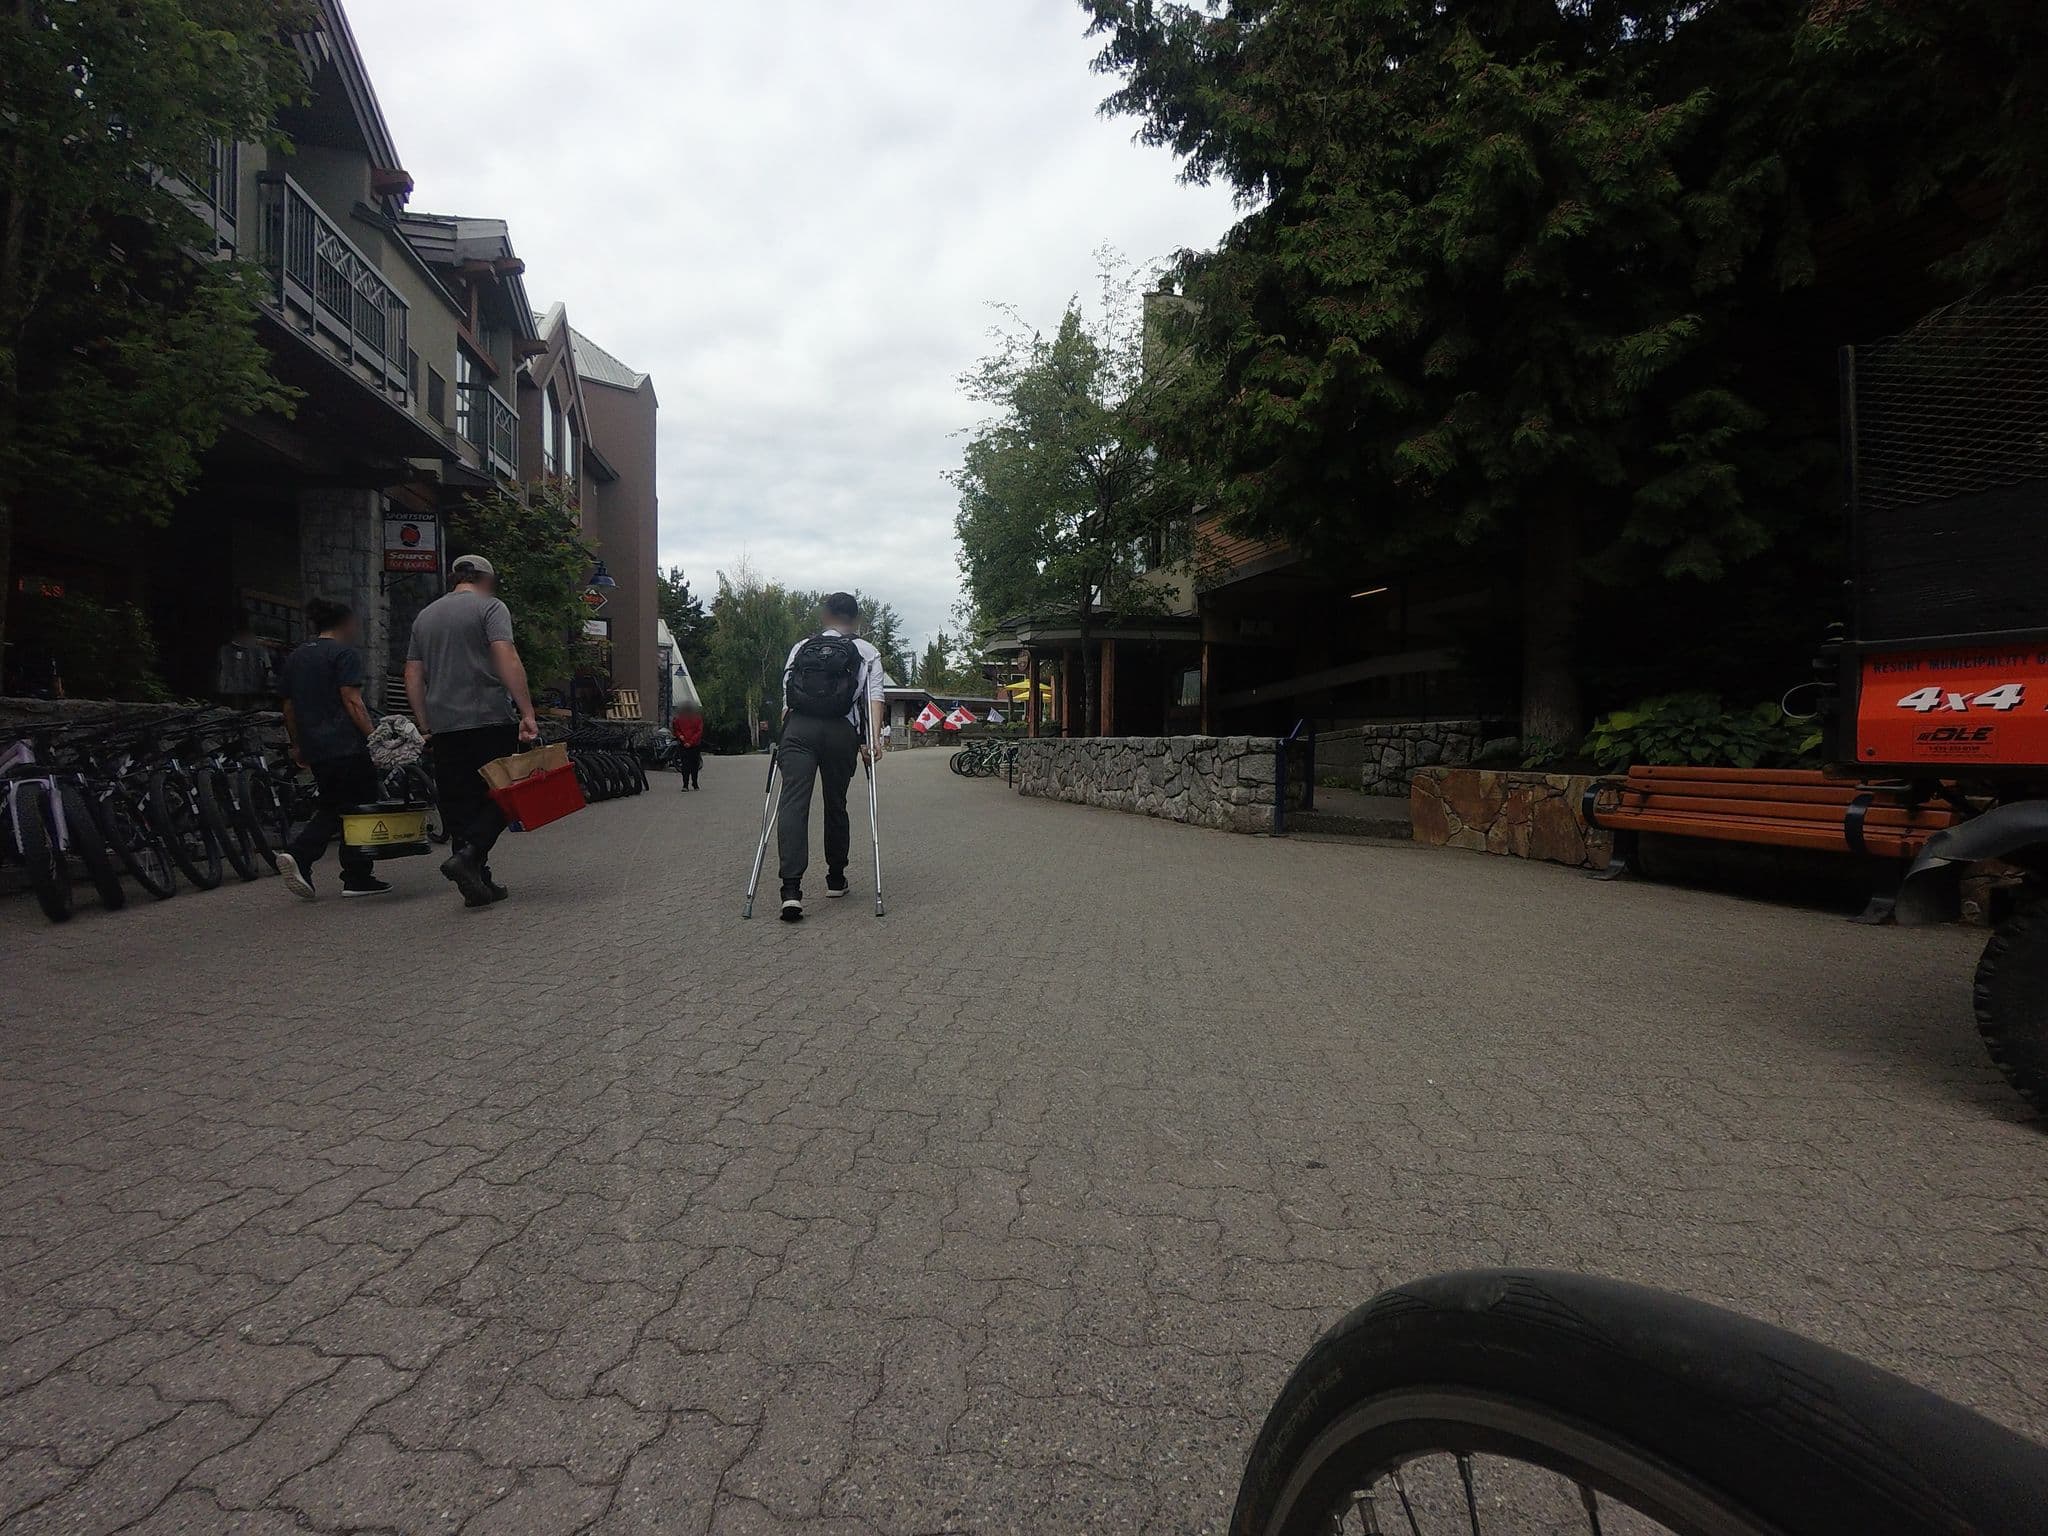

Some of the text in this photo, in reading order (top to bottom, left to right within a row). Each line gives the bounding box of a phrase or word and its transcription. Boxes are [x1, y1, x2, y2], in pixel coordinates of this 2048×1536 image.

[388, 552, 433, 560] Source
[1874, 659, 1921, 673] RESORT
[1930, 655, 2028, 670] MUNICIPALITY
